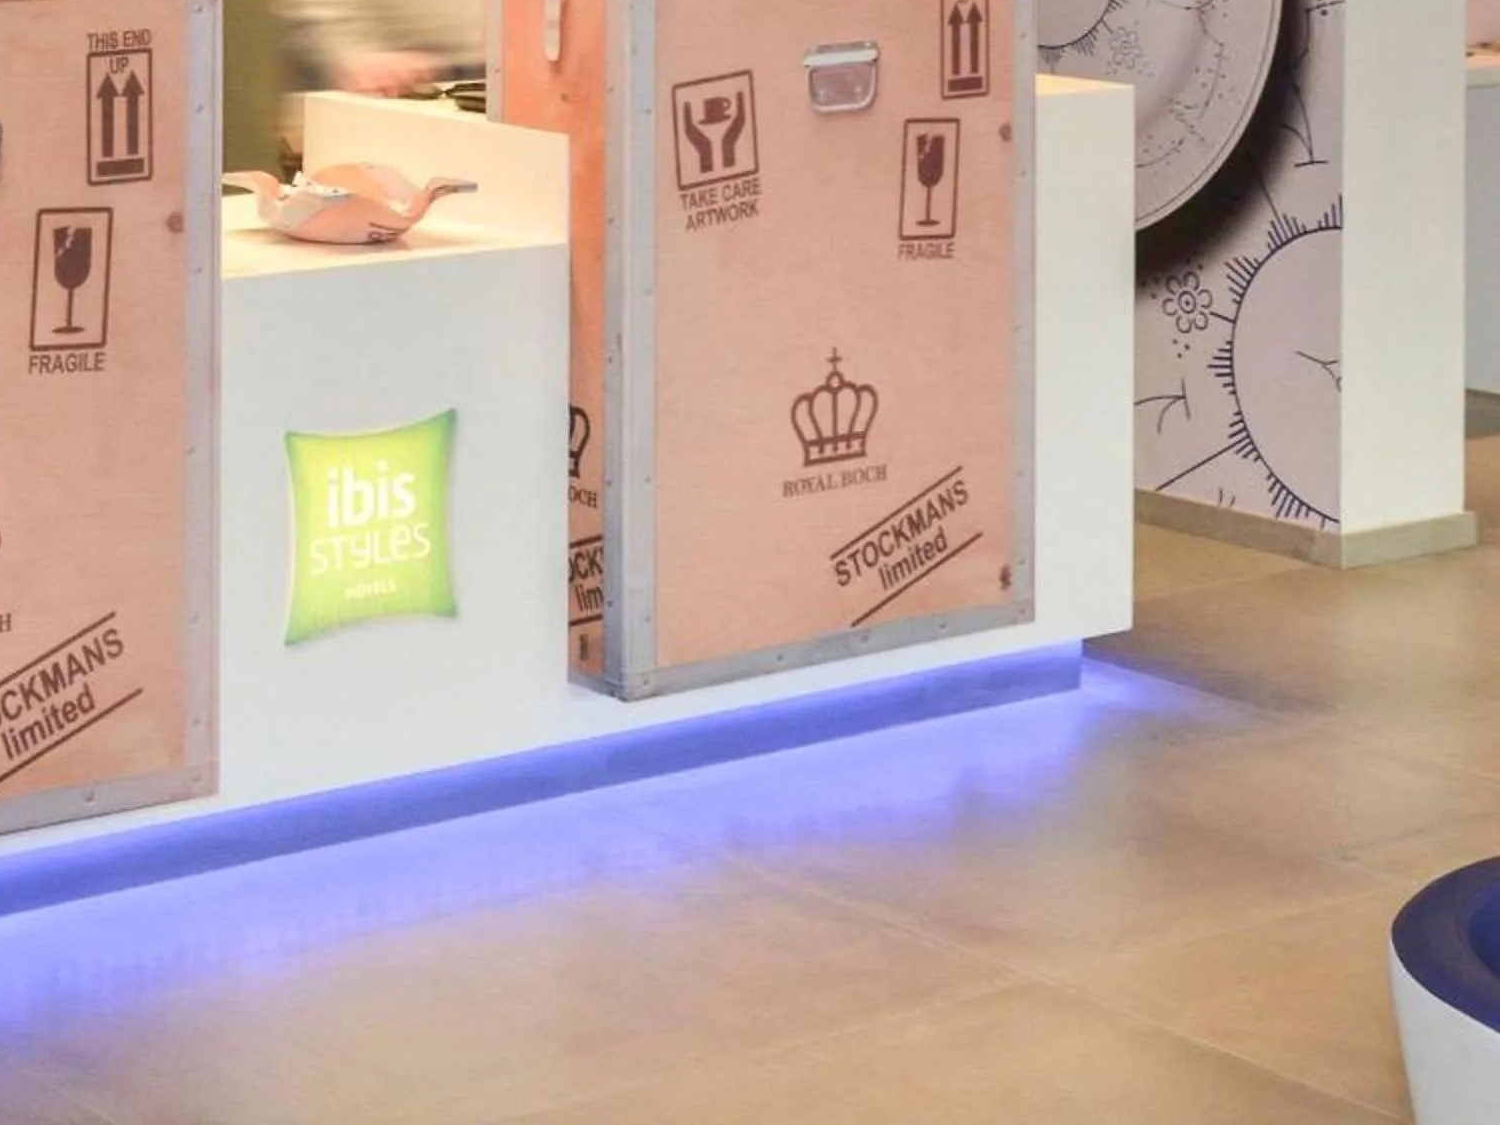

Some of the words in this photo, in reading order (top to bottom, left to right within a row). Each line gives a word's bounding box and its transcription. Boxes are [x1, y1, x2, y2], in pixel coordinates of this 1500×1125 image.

[87, 31, 118, 50] THIS
[123, 28, 151, 48] END
[109, 56, 129, 74] UP
[680, 187, 718, 211] TAKE
[722, 177, 762, 201] CARE
[685, 198, 759, 230] ARTWORK
[897, 242, 956, 263] FRAGILE
[28, 351, 107, 375] FRAGILE
[326, 459, 416, 530] ibis
[782, 475, 840, 498] ROYAL
[840, 463, 887, 488] BOCH
[568, 485, 598, 510] OCH
[834, 479, 969, 587] STOCKMANS
[878, 525, 948, 591] limited
[1, 682, 96, 761] limited
